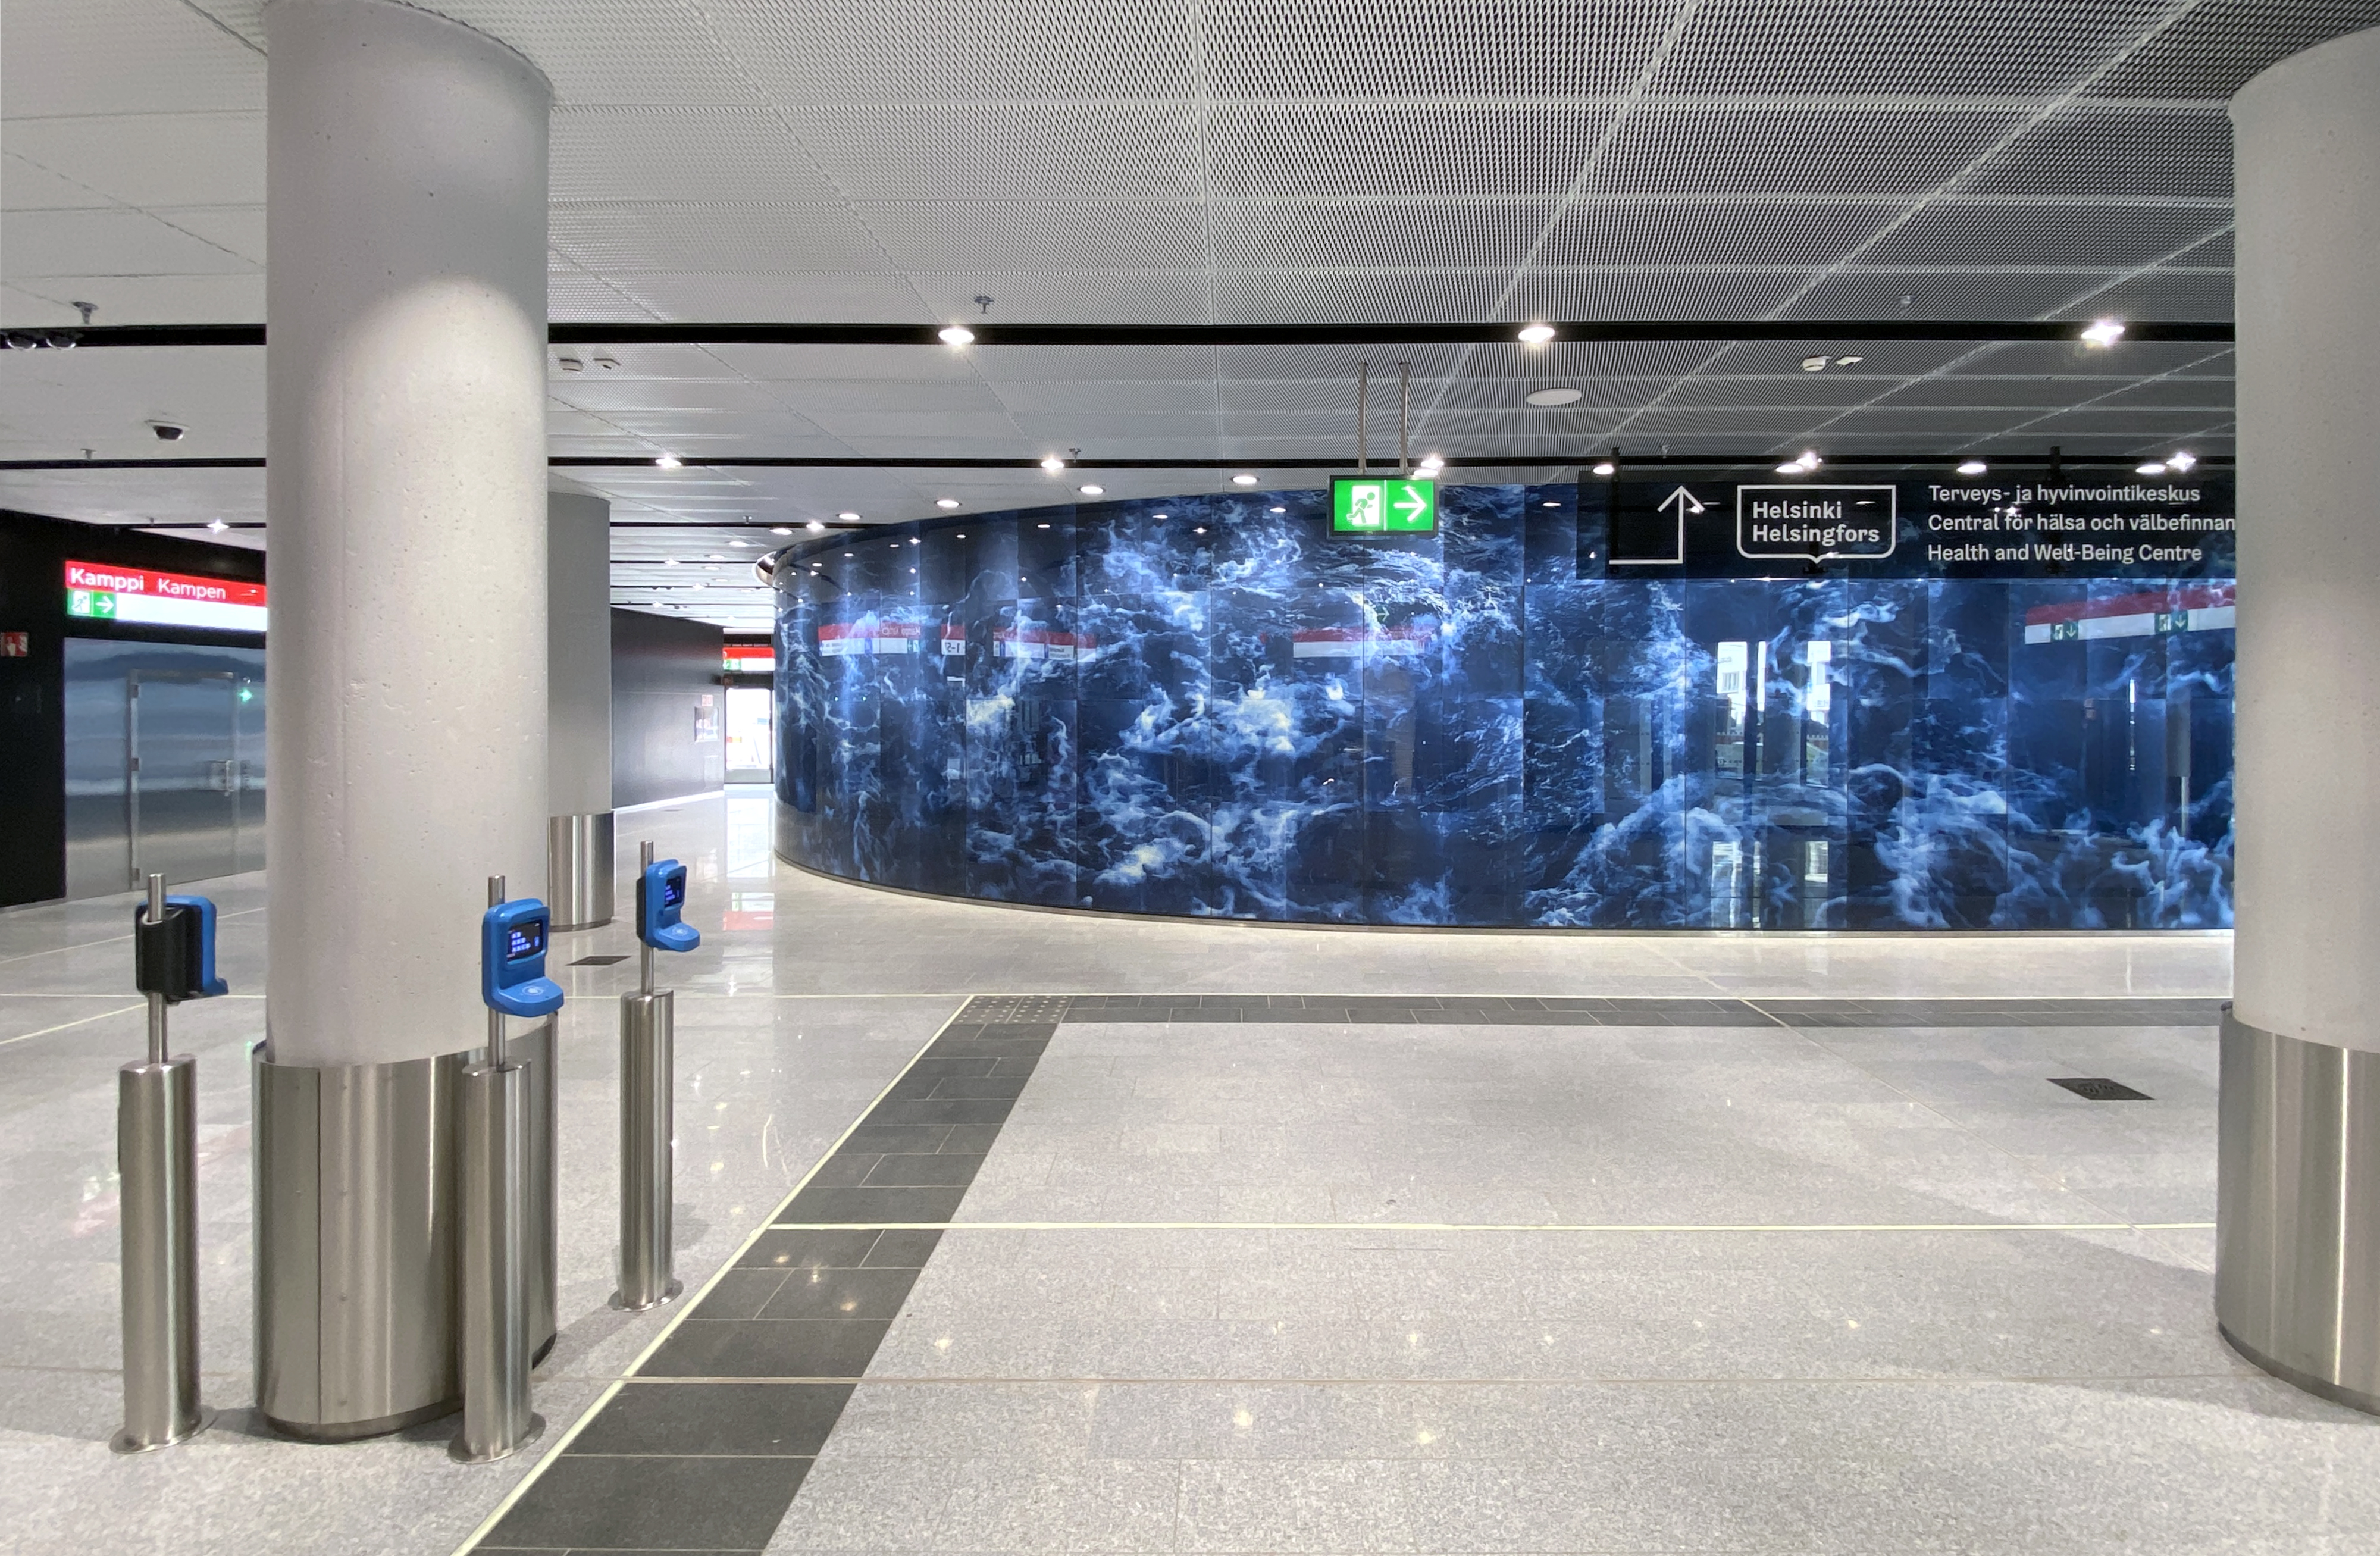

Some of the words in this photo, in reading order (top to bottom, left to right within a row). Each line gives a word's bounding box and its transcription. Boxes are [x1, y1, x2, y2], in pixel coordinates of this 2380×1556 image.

[1928, 485, 2011, 505] Terveys-
[2015, 485, 2033, 504] ja
[2037, 485, 2201, 505] hyvinvointikeskus
[1752, 500, 1842, 519] Helsinki
[1928, 515, 2000, 531] Central
[2004, 514, 2033, 531] för
[2037, 514, 2086, 531] hälsa
[2090, 514, 2125, 531] och
[1752, 524, 1880, 547] Helsingfors
[1928, 544, 1990, 561] Health
[1995, 544, 2029, 561] and
[2034, 544, 2135, 565] Well-Being
[2138, 544, 2203, 561] Centre
[70, 568, 145, 591] Kamppi
[158, 578, 226, 600] Kampen
